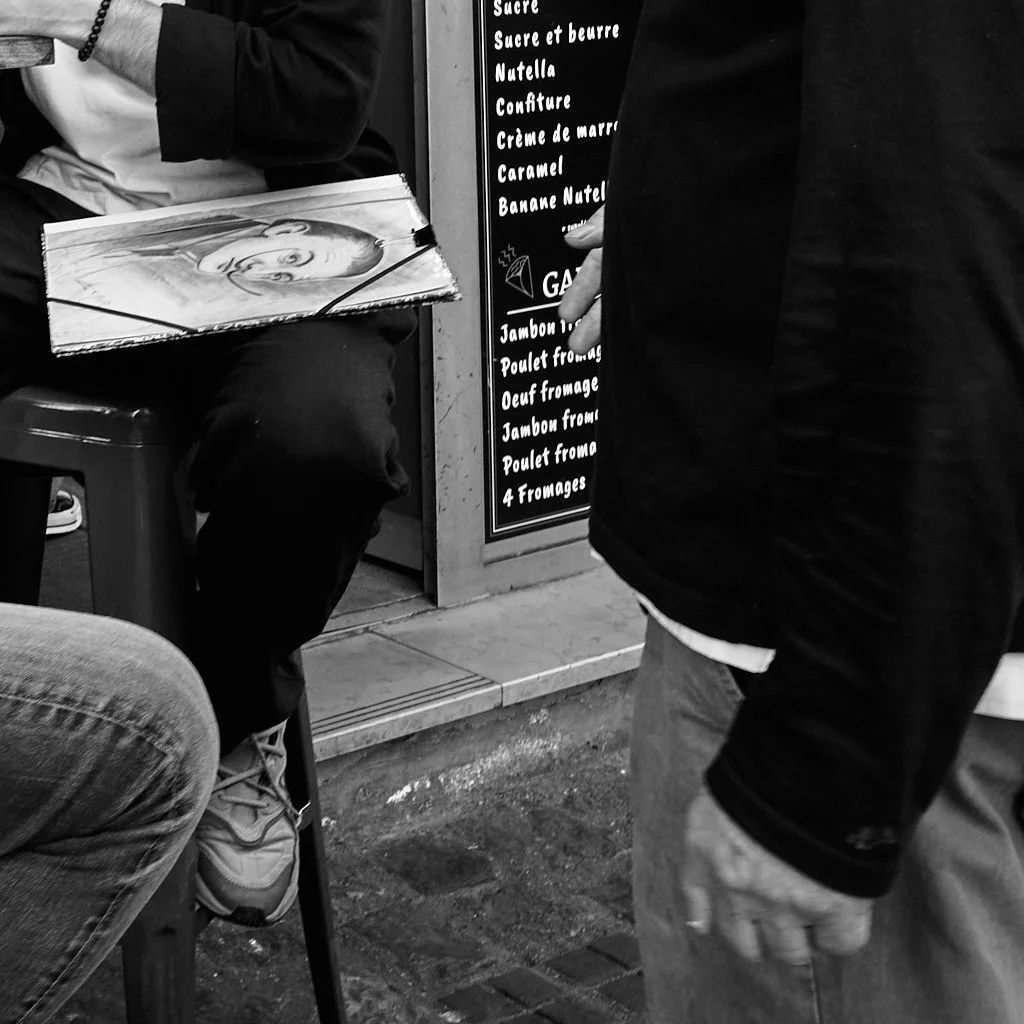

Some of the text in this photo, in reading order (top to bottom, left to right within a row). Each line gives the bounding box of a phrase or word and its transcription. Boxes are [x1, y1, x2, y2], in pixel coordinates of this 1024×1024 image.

[495, 22, 619, 50] Sucre et beurre
[496, 59, 555, 82] Nutella
[496, 92, 570, 116] Confiture
[497, 128, 545, 149] Crème
[553, 123, 570, 143] de
[498, 155, 563, 183] Caramel
[499, 181, 605, 216] Banane Nutel
[500, 318, 555, 343] Jambon
[501, 350, 548, 377] Poulet
[502, 377, 598, 410] Oeuf fromage
[502, 416, 557, 442] Jambon
[502, 442, 596, 475] Poulet froma
[503, 476, 585, 507] 4 Fromages
